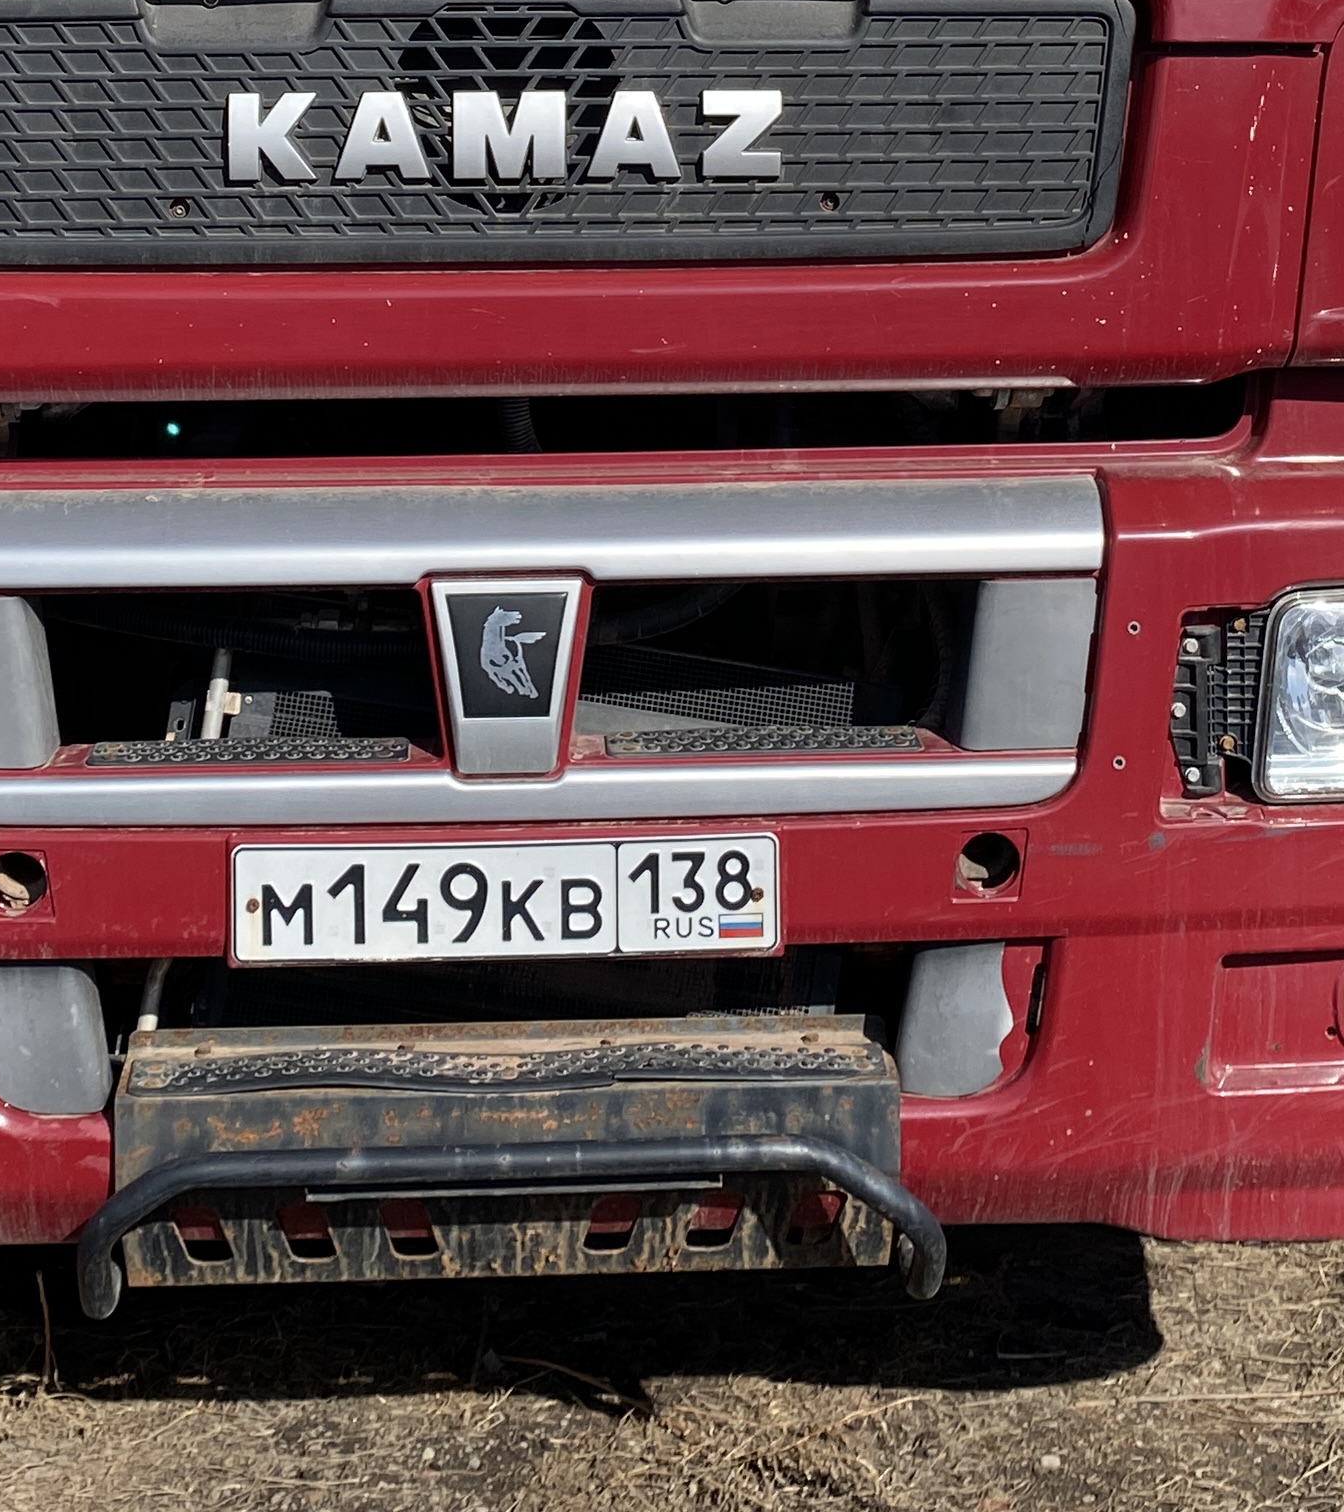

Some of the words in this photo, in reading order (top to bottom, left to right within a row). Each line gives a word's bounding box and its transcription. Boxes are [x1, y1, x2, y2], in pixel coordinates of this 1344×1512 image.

[227, 90, 784, 181] KAMAZ
[261, 862, 604, 946] М149КВ
[628, 850, 752, 914] 138
[653, 916, 715, 940] RUS
